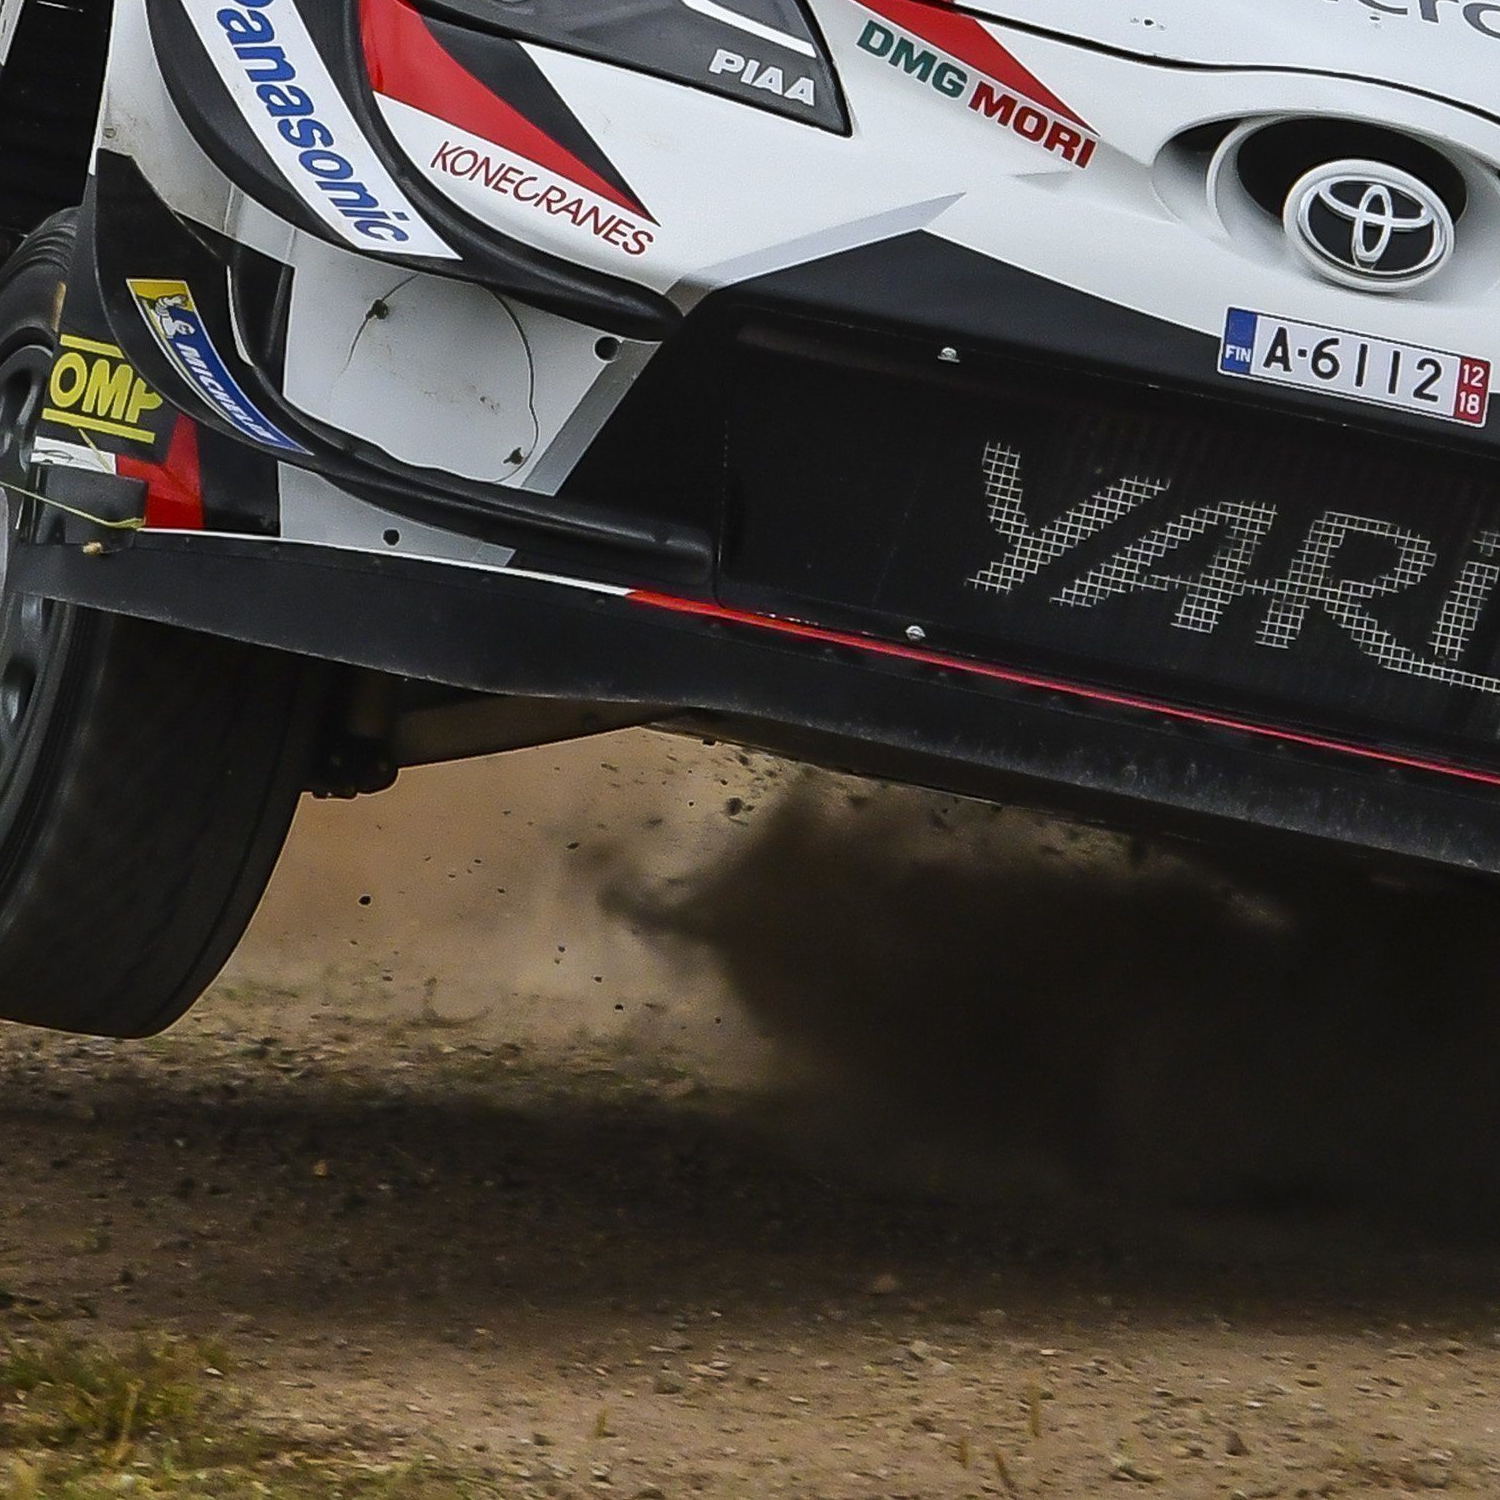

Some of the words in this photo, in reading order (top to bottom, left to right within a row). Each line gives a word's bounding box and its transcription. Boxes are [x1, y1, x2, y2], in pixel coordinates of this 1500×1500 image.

[708, 48, 838, 108] PIAA
[856, 19, 968, 99] DMG
[967, 81, 1098, 170] MORI
[430, 140, 655, 258] KONECRANES
[1224, 343, 1251, 364] FIN
[1462, 363, 1485, 389] 12
[49, 351, 164, 424] OMP
[174, 341, 283, 444] MICHELIN
[1458, 389, 1481, 415] 18
